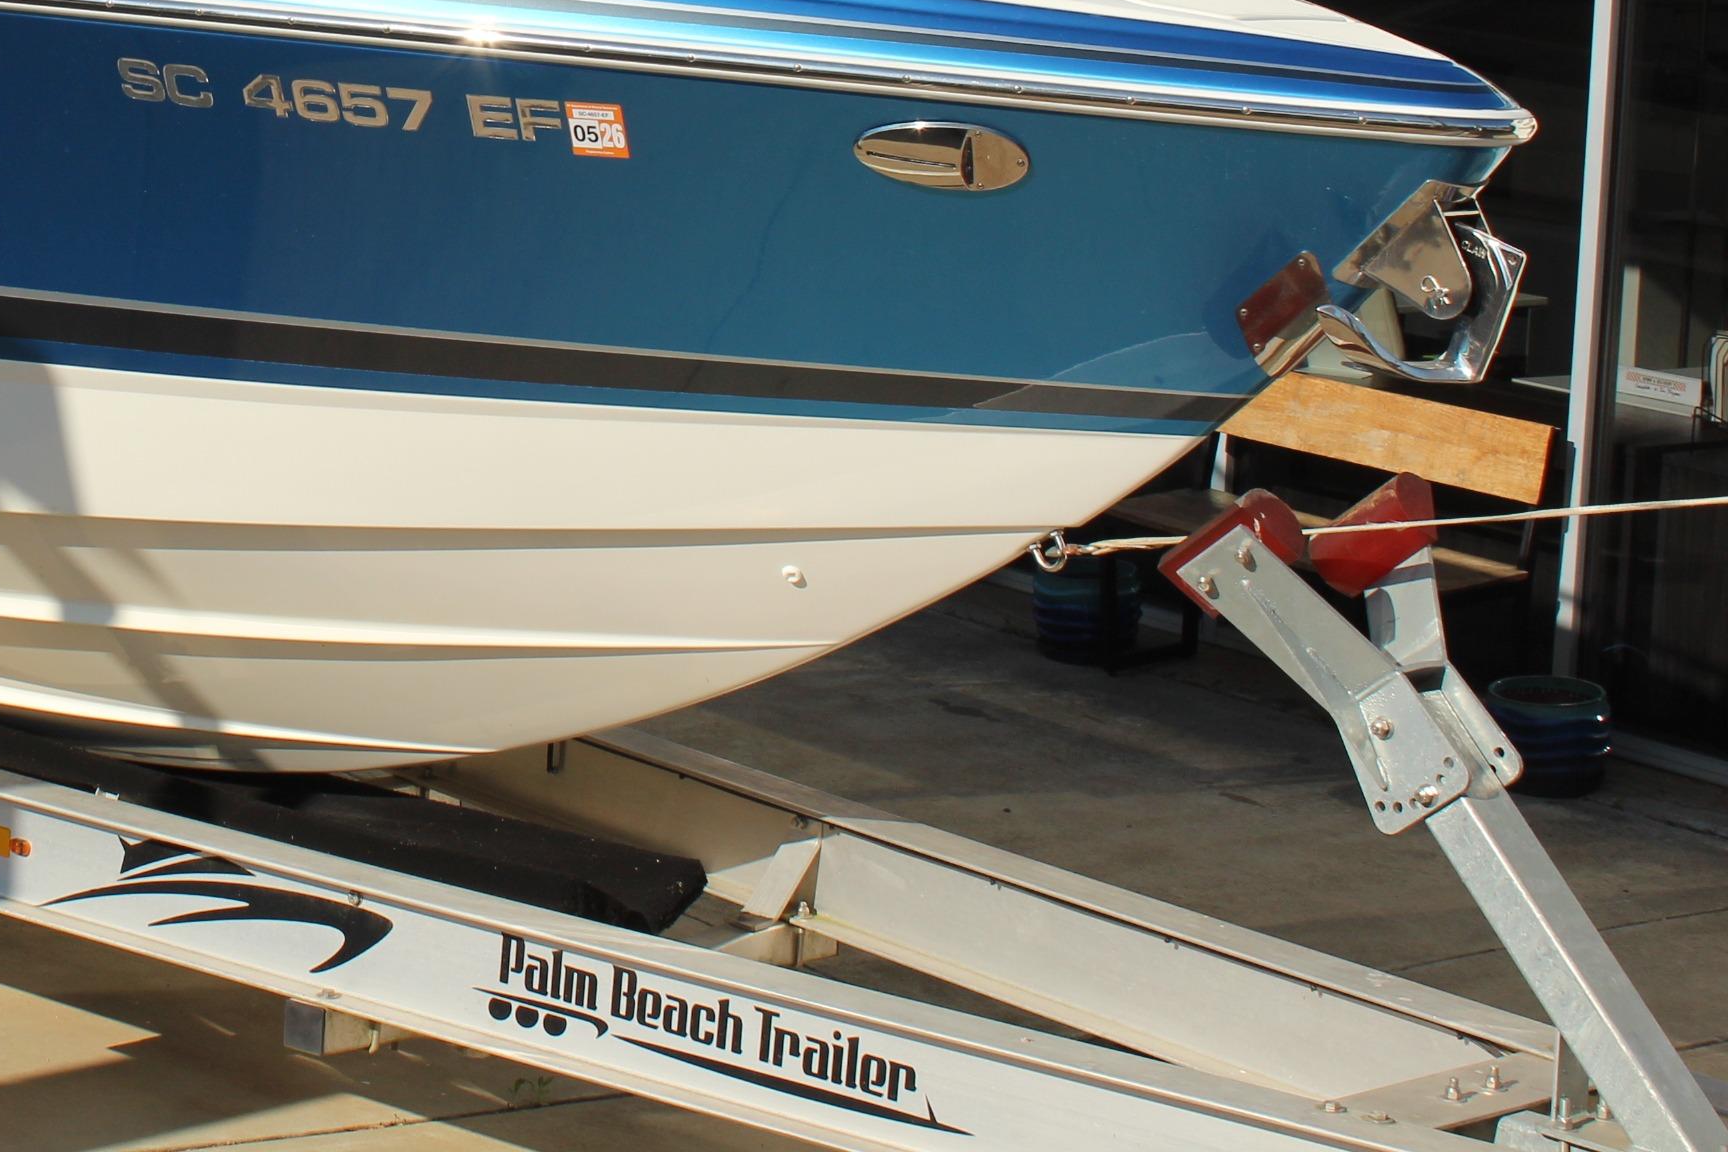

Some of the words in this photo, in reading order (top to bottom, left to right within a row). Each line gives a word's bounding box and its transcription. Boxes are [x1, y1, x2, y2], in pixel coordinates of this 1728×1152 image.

[117, 57, 214, 109] SC
[242, 73, 433, 132] 4657
[465, 93, 563, 142] EF
[573, 124, 599, 143] 05
[600, 122, 626, 149] 26
[499, 931, 599, 1011] Palm
[610, 964, 743, 1055] Beach
[754, 1005, 918, 1102] Trailer
